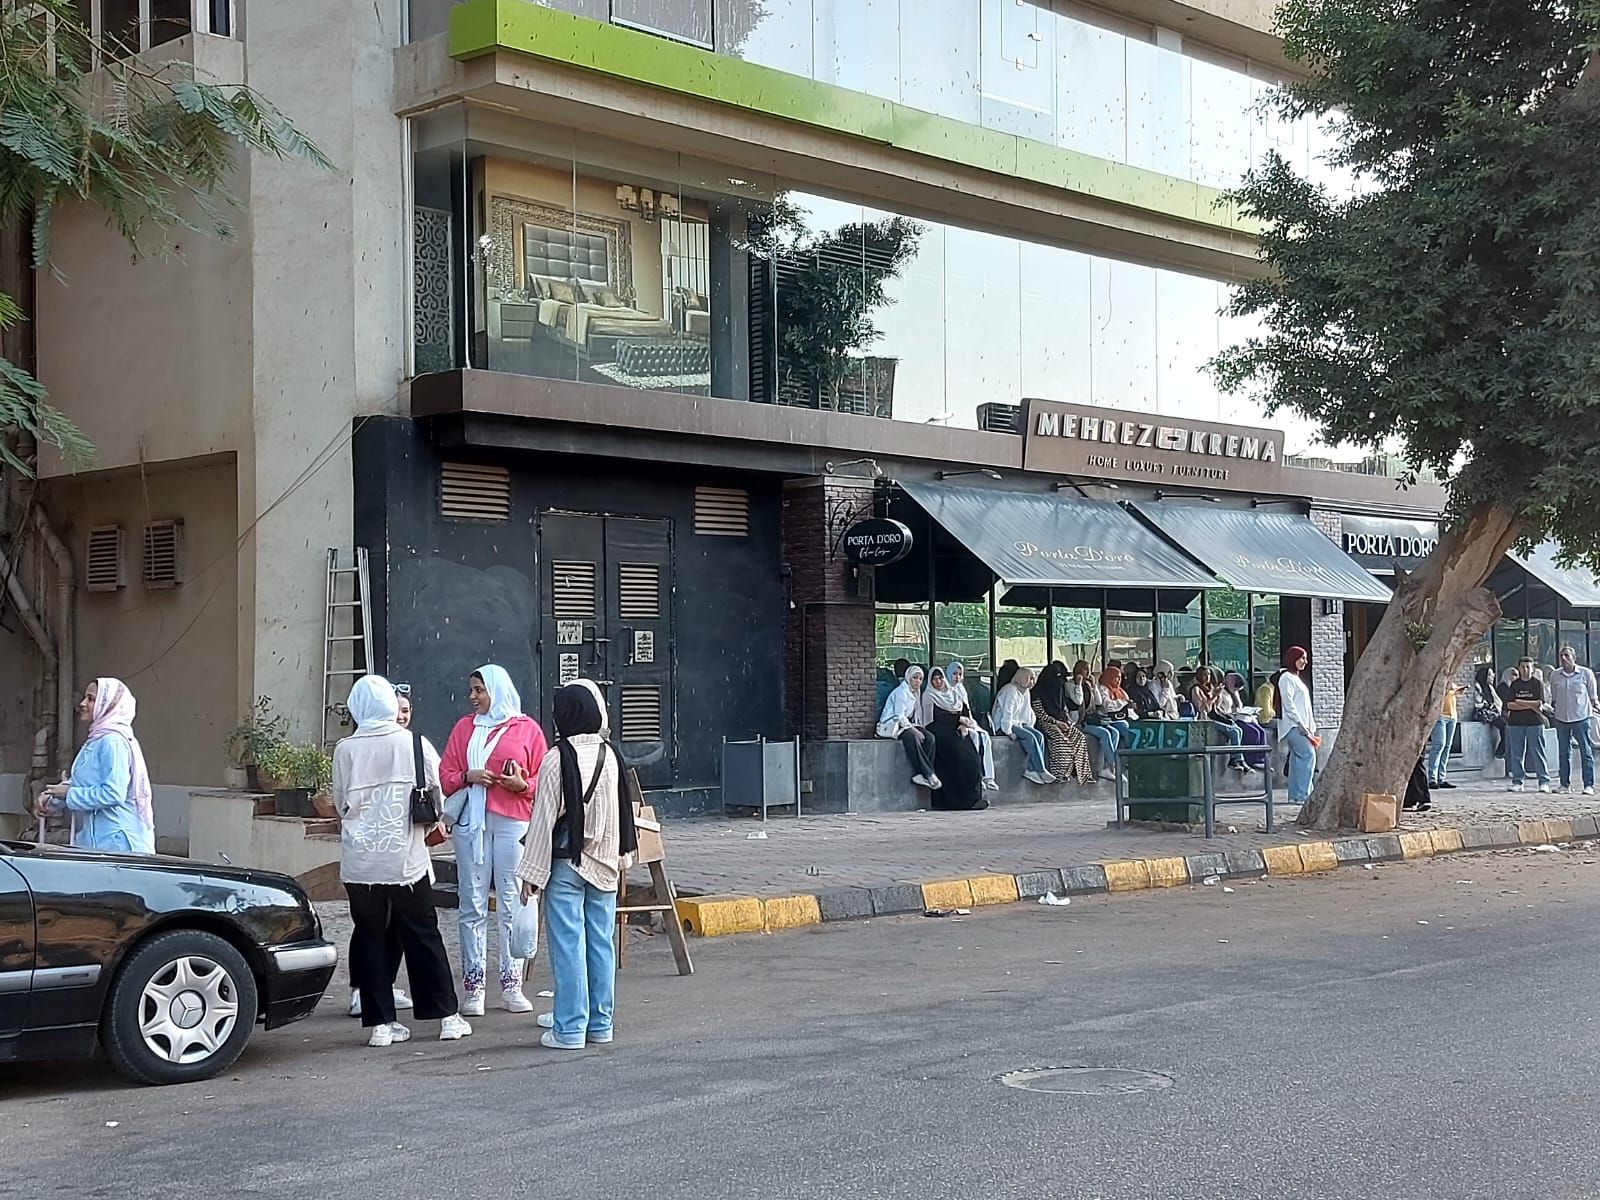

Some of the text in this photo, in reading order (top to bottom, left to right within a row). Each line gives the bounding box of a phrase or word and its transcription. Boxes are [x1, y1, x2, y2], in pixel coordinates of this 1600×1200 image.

[1037, 411, 1277, 463] MEHREZ KREMA
[1088, 454, 1118, 469] HOME
[1171, 464, 1230, 481] FURNITURE
[847, 533, 901, 546] PORTA D'ORO
[1013, 541, 1078, 560] Porta
[1343, 532, 1397, 556] PORTA
[360, 785, 404, 805] LOVE
